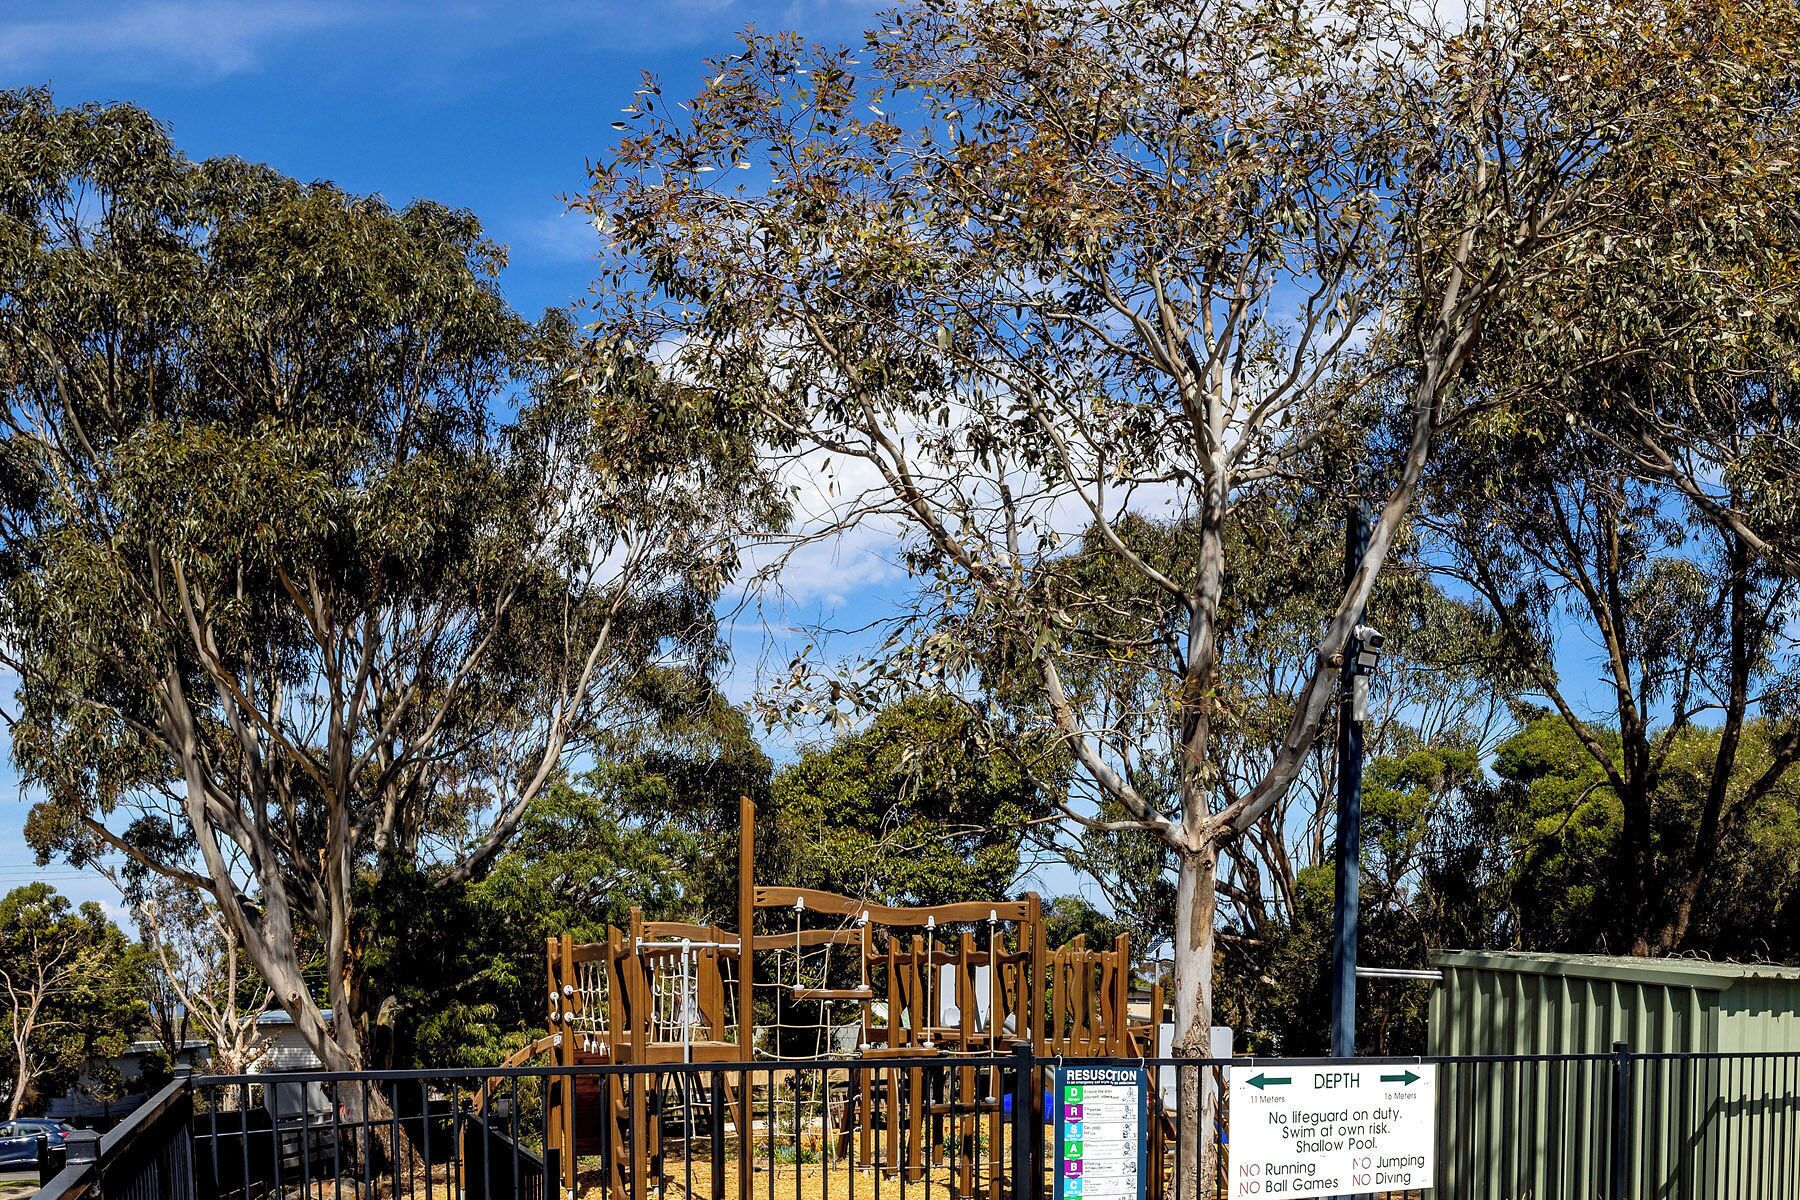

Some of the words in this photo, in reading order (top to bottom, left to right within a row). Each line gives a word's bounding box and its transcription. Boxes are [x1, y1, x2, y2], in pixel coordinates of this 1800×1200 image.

[1315, 1073, 1359, 1089] DEPTH
[1070, 1087, 1078, 1097] D
[1070, 1107, 1078, 1116] R
[1269, 1112, 1287, 1124] No
[1293, 1109, 1347, 1126] lifeguard
[1354, 1111, 1368, 1121] on
[1373, 1107, 1402, 1122] duty.
[1070, 1125, 1078, 1134] S
[1283, 1126, 1315, 1139] Swim
[1321, 1125, 1332, 1137] at
[1338, 1126, 1364, 1136] own
[1369, 1122, 1390, 1134] risk.
[1070, 1143, 1078, 1153] A
[1296, 1140, 1343, 1153] Shallow
[1349, 1137, 1377, 1150] Pool.
[1070, 1162, 1078, 1172] B
[1240, 1164, 1260, 1177] NO
[1266, 1162, 1315, 1176] Running
[1353, 1157, 1371, 1170] NO
[1377, 1154, 1424, 1169] Jumping
[1070, 1181, 1078, 1190] C
[1240, 1181, 1260, 1194] NO
[1266, 1180, 1287, 1192] Ball
[1293, 1176, 1338, 1191] Games
[1352, 1174, 1371, 1187] NO
[1376, 1172, 1410, 1185] Diving
